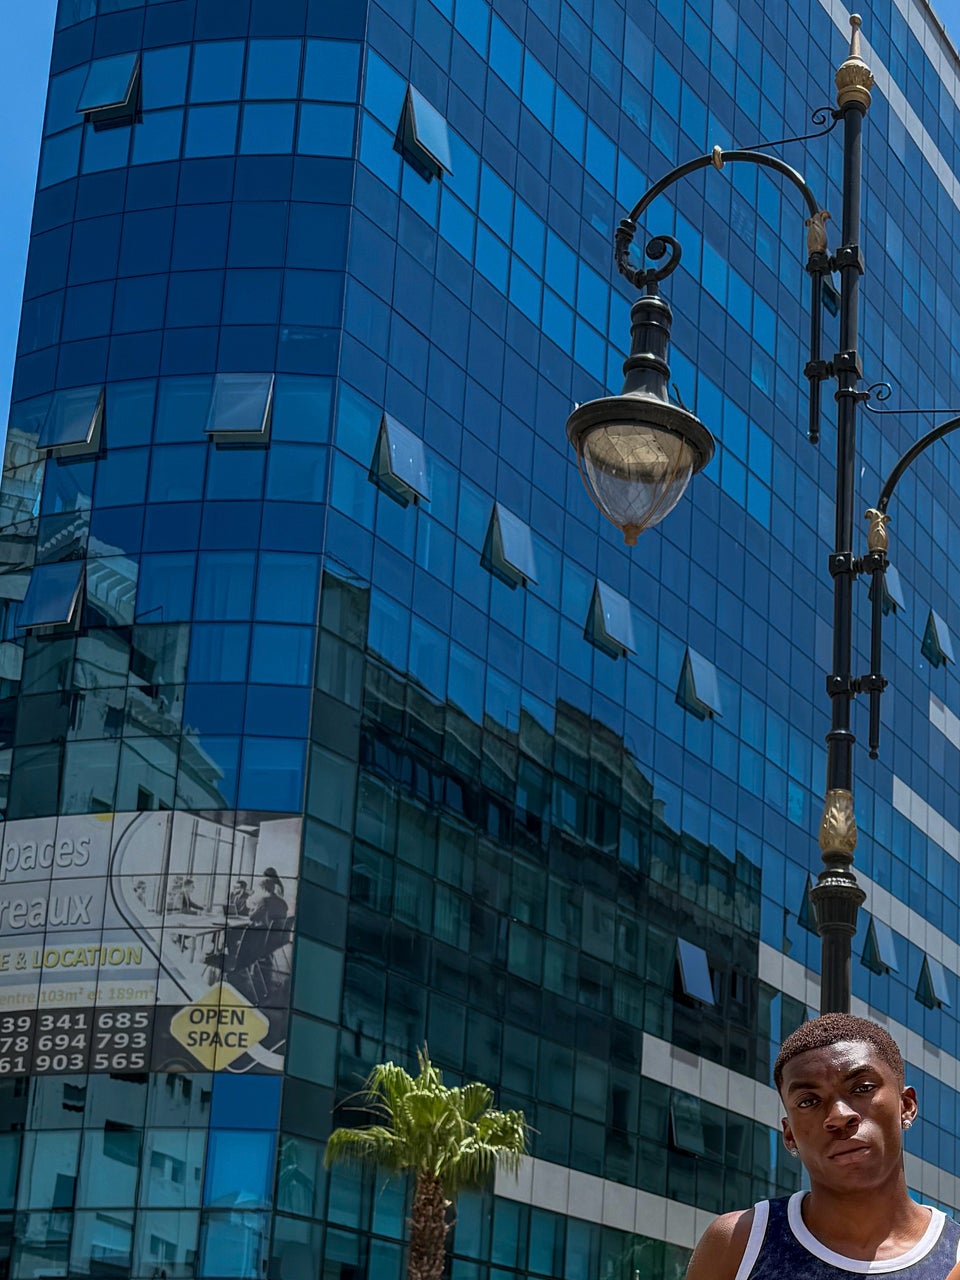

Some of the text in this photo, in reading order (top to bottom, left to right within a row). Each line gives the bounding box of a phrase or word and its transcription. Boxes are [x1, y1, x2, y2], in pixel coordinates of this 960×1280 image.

[32, 945, 143, 969] LOCATION
[40, 1013, 88, 1031] 341
[98, 1012, 149, 1029] 685
[189, 1008, 245, 1025] OPEN
[38, 1034, 87, 1051] 694
[96, 1032, 147, 1049] 793
[186, 1031, 249, 1048] SPACE
[36, 1054, 85, 1072] 903
[94, 1053, 145, 1069] 565
